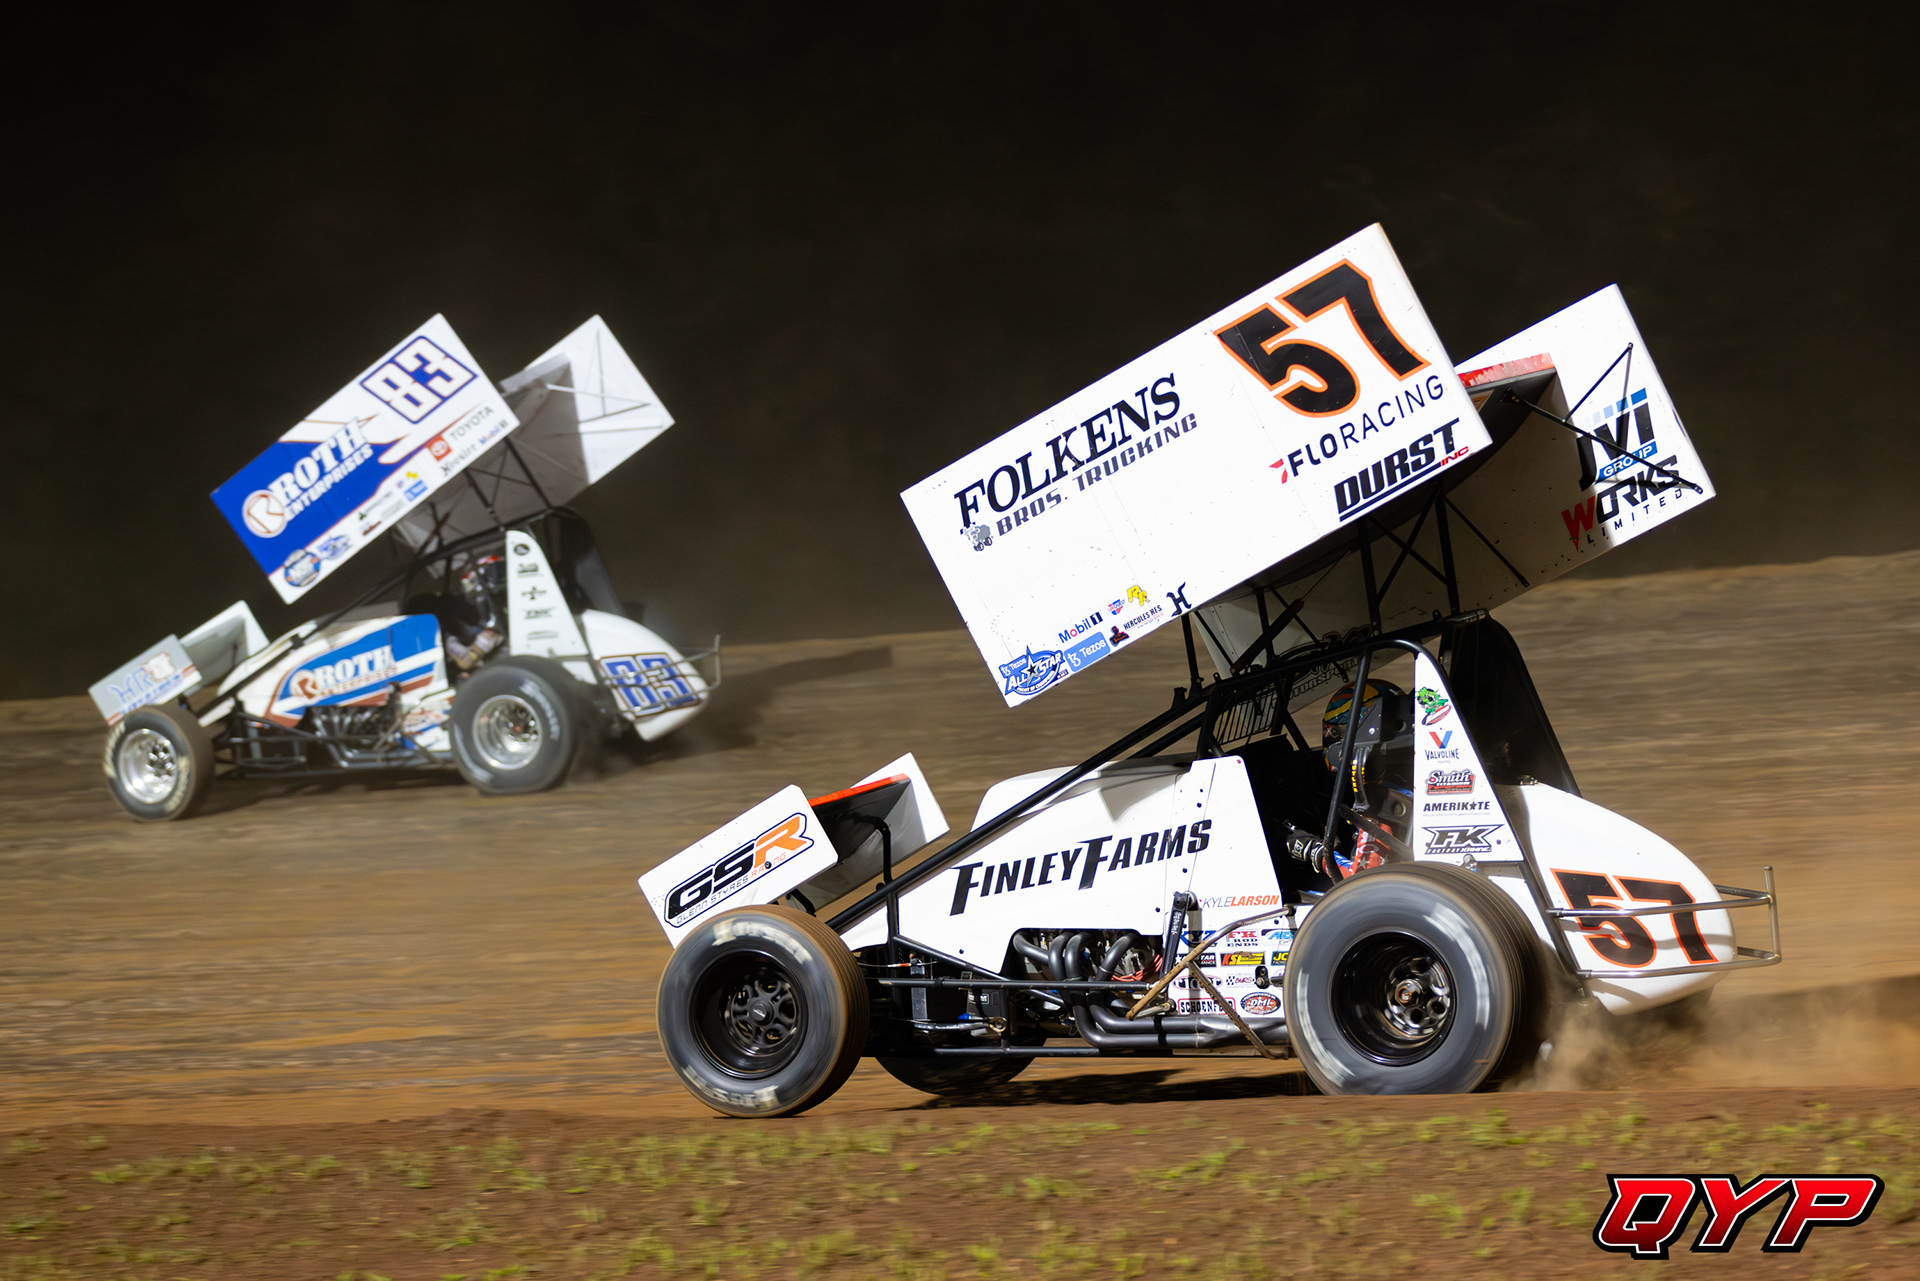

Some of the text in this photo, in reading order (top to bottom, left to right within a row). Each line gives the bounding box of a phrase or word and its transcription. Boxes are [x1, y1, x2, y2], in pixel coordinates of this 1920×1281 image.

[1212, 257, 1433, 419] 57
[360, 336, 478, 424] 83
[449, 405, 495, 441] TOYOTA
[267, 416, 370, 508] ROTH
[953, 372, 1181, 535] FOLKENS
[996, 412, 1198, 537] BROS. TRUCKING
[1334, 417, 1470, 516] DURST INC
[1602, 445, 1653, 477] GROUP
[1561, 455, 1680, 551] WORKS
[1586, 488, 1683, 544] LIMITED
[1058, 617, 1092, 643] Mobil
[1079, 639, 1107, 658] Tezos
[313, 645, 396, 689] ROTH
[600, 652, 700, 718] 83
[1009, 657, 1027, 670] Tezos
[1039, 652, 1062, 675] STAR
[1424, 748, 1459, 760] VALVOLINE
[1426, 769, 1472, 785] Smith
[1423, 825, 1500, 848] FK
[668, 816, 808, 920] GSR
[676, 852, 787, 925] GLENN STYRES RAING
[950, 819, 1212, 917] FINLEY FARMS
[1230, 895, 1280, 907] LARSON
[1549, 867, 1720, 969] 57
[1250, 998, 1271, 1006] DMI
